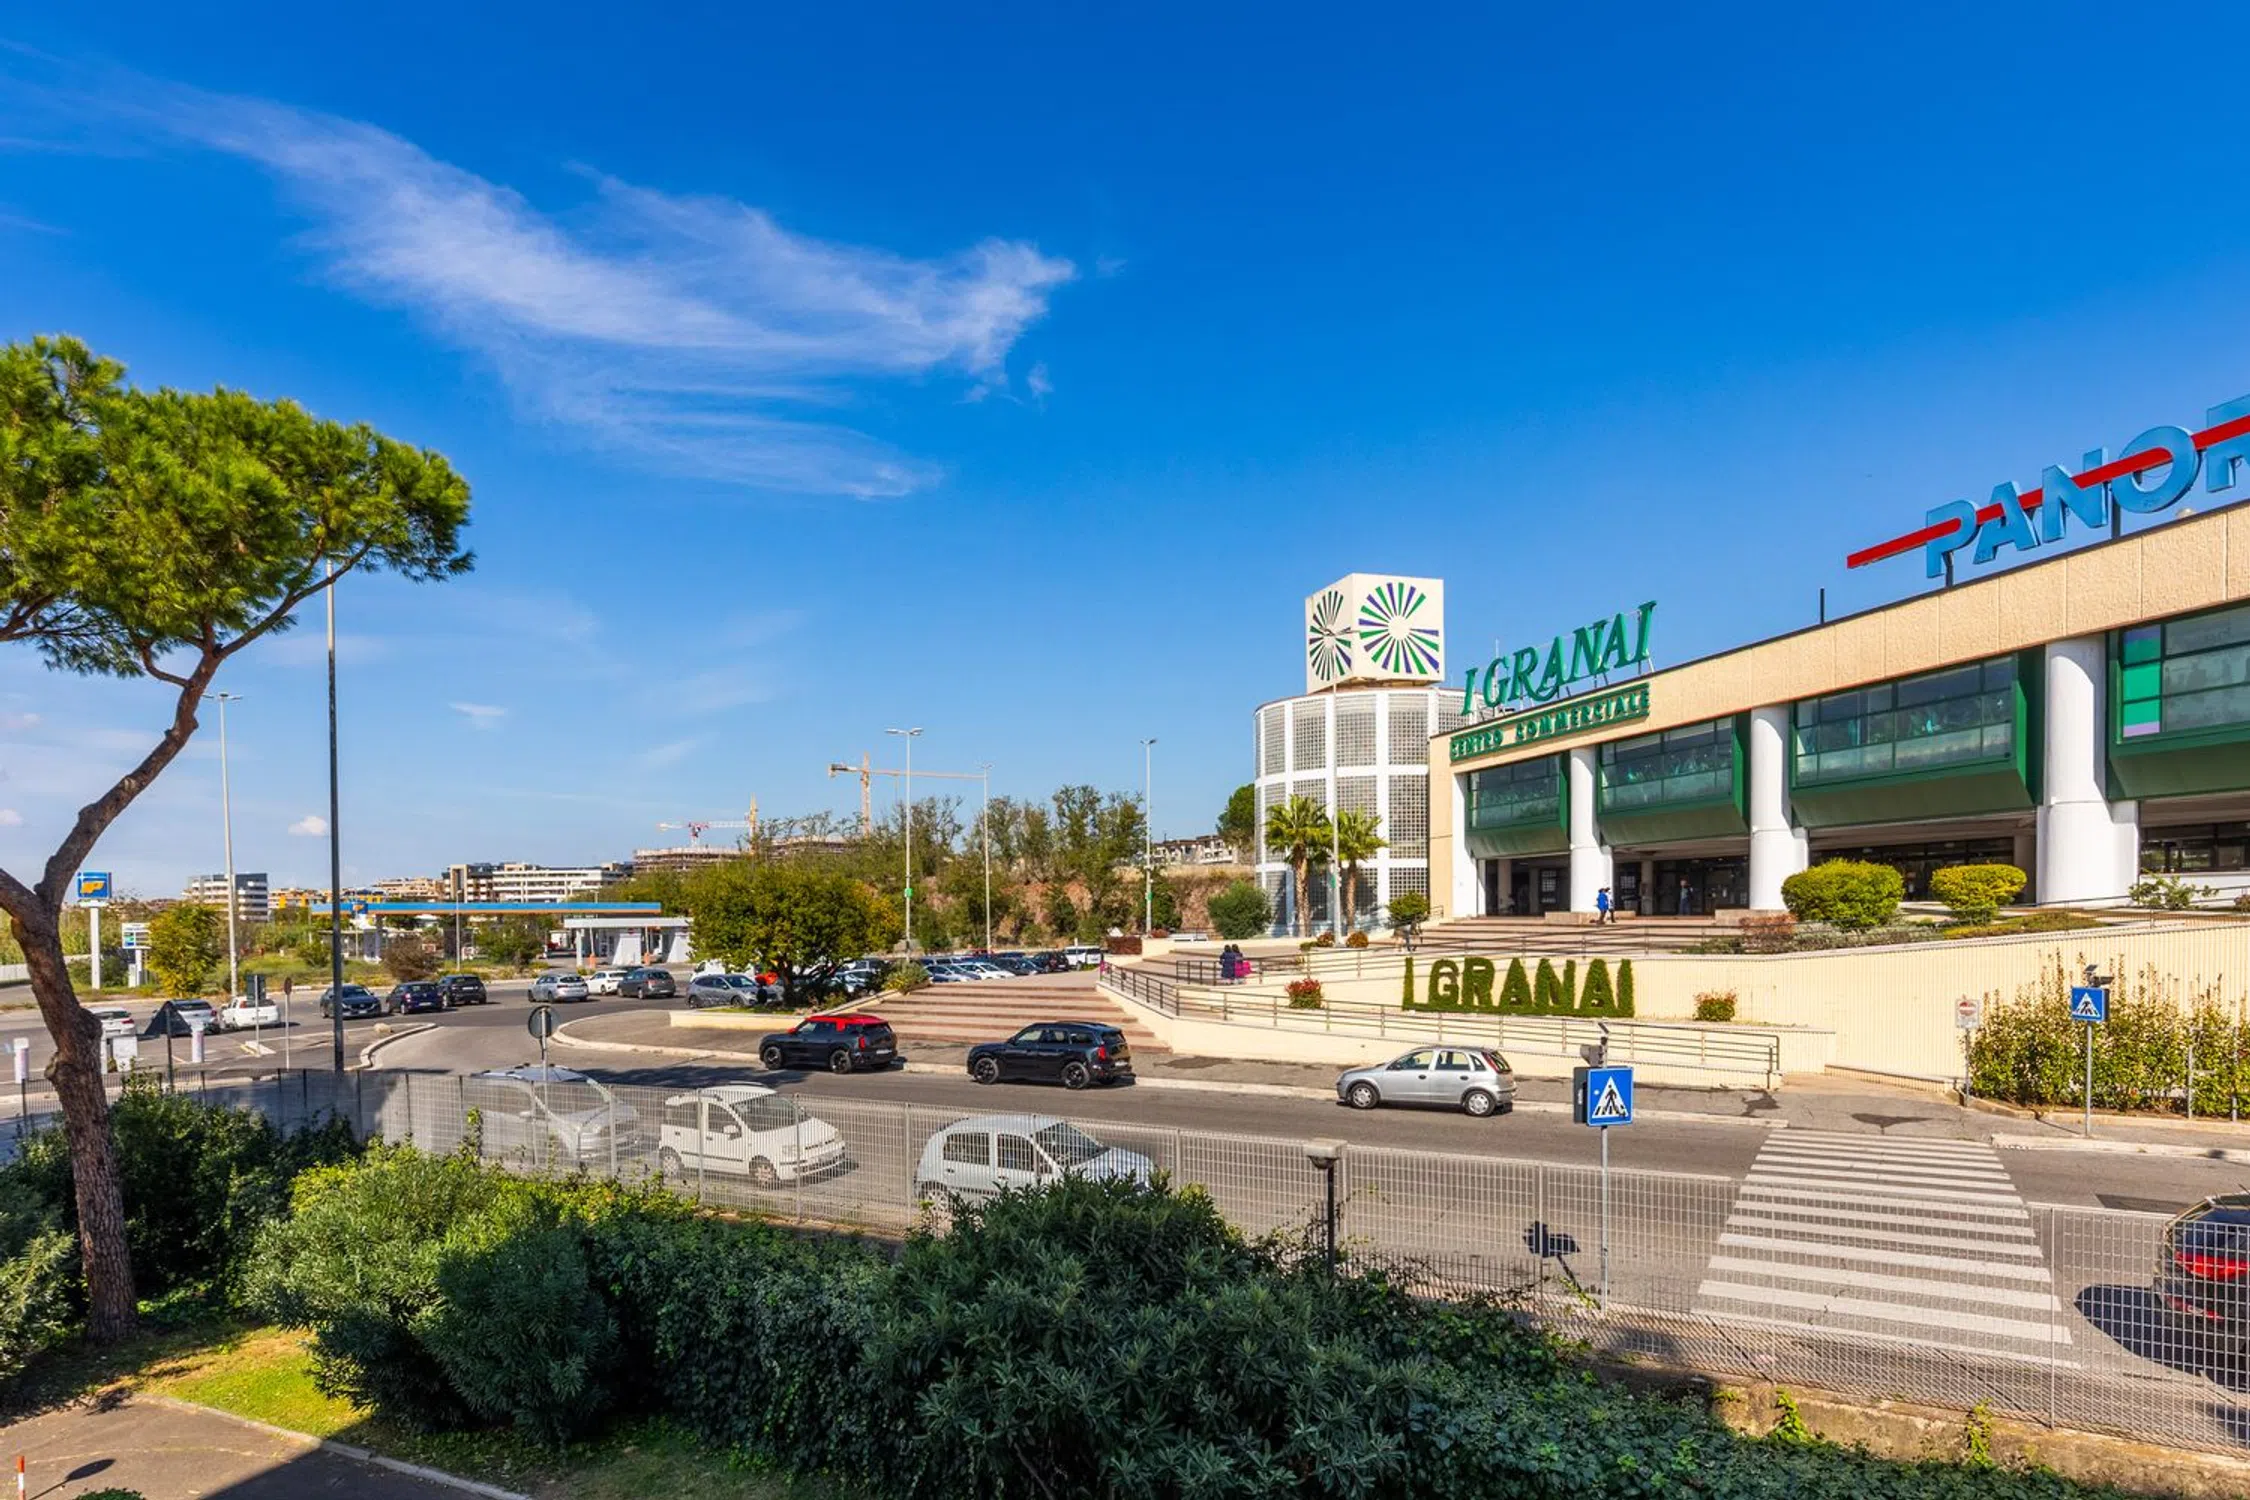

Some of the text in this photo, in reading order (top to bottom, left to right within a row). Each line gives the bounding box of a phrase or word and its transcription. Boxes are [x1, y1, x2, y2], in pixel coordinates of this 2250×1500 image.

[1461, 601, 1657, 716] I GRANAI
[1451, 690, 1650, 758] CENTRO COMMERCIALE
[1402, 957, 1634, 1018] I GRANAI
